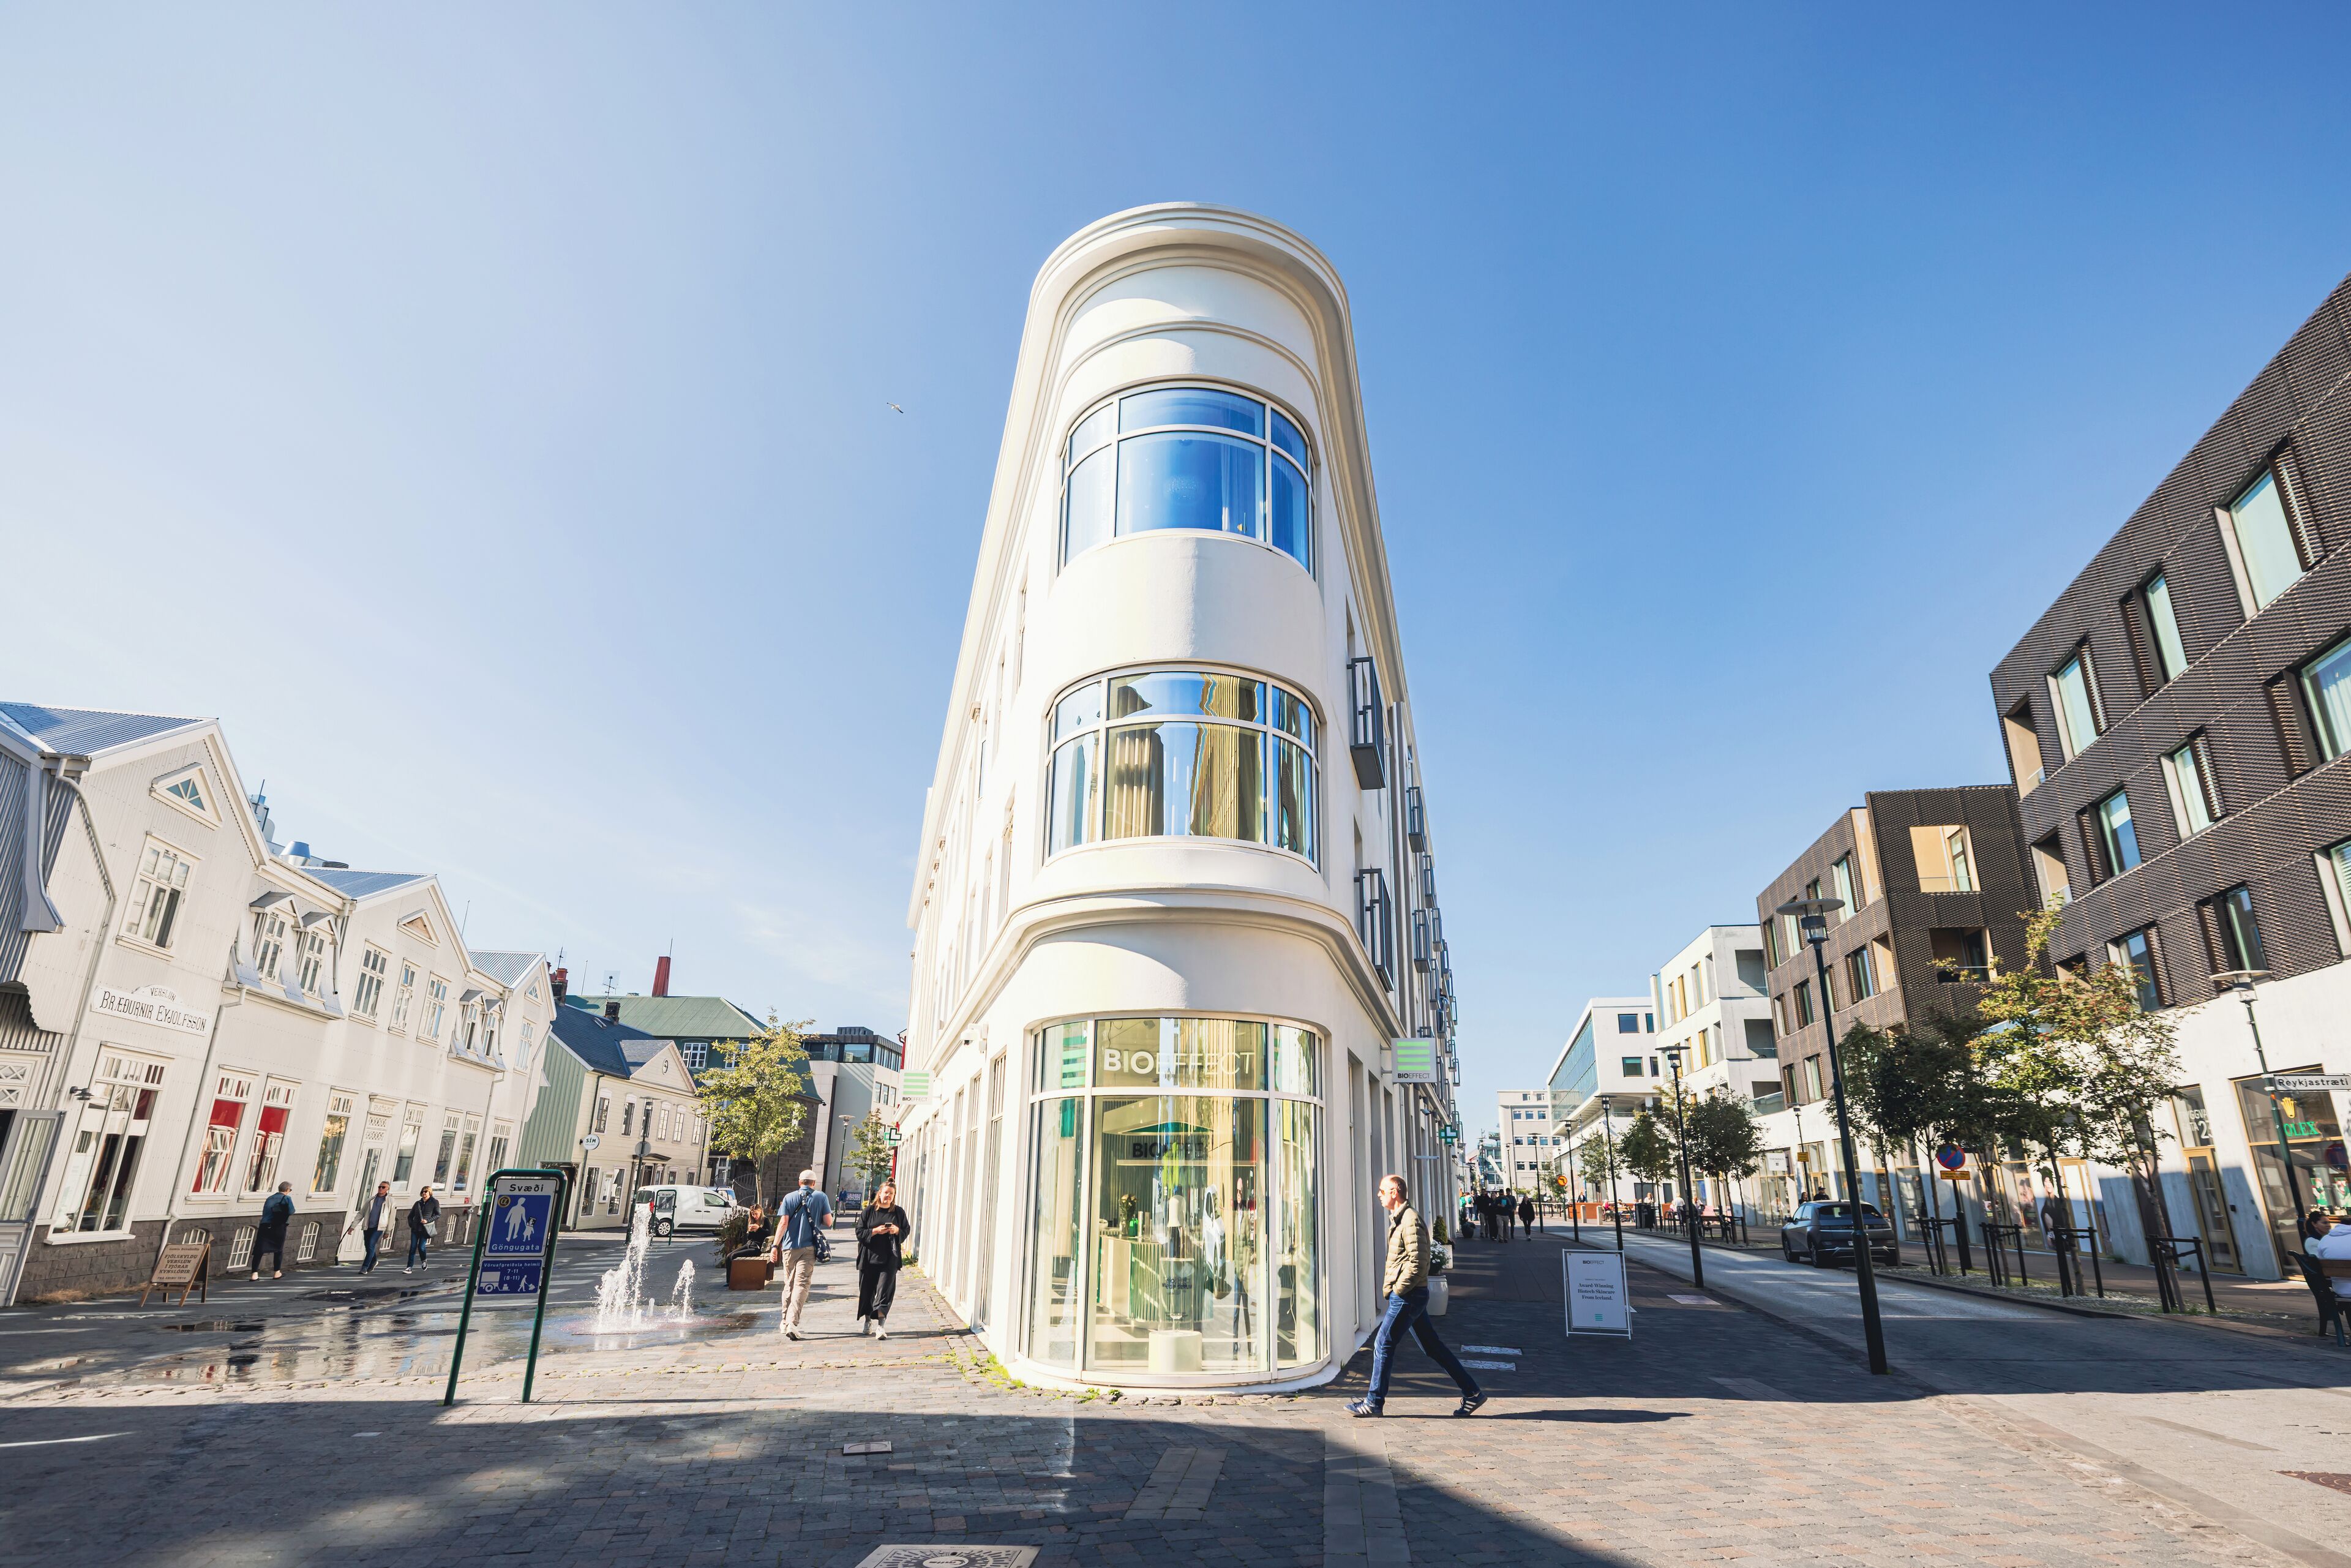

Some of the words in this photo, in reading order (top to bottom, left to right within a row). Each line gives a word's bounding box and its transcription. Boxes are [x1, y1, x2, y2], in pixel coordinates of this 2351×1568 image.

[150, 987, 176, 1002] VERSLUN
[99, 990, 154, 1020] BRÆÐURNIR
[156, 1005, 208, 1032] EYJOLFSSON
[1103, 1048, 1255, 1075] BIOEFFECT
[2278, 1076, 2350, 1088] Reykjastræti
[2283, 1120, 2321, 1137] OLEX
[509, 1184, 544, 1193] Svæði
[491, 1243, 540, 1251] Göngugata
